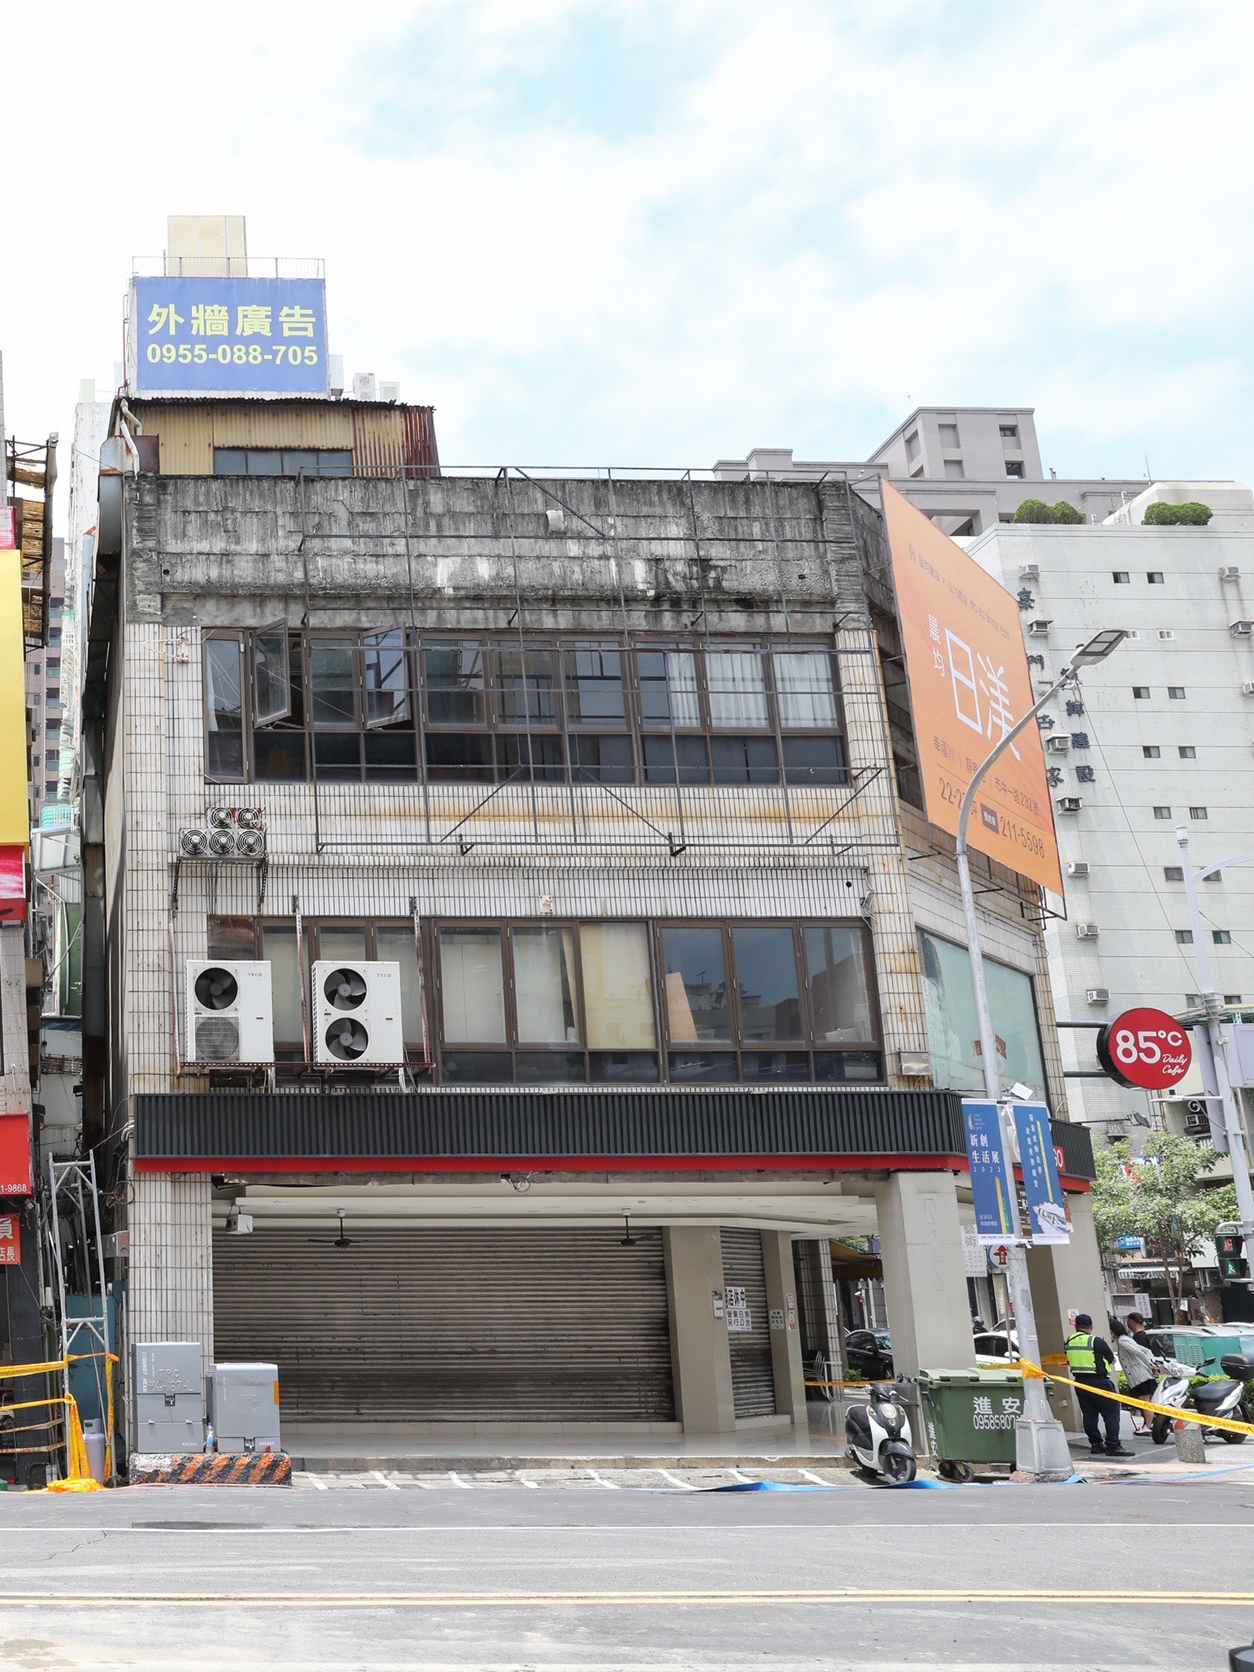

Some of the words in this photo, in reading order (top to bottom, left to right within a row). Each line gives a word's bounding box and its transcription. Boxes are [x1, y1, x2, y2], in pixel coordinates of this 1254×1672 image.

[147, 303, 317, 338] 外牆廣告
[147, 343, 319, 366] 0955-088-705
[999, 815, 1045, 859] 211-5598
[1115, 1029, 1183, 1064] 85°C
[1162, 1053, 1188, 1064] Daily
[971, 1150, 1001, 1164] 生活展
[972, 1396, 1021, 1415] 進安
